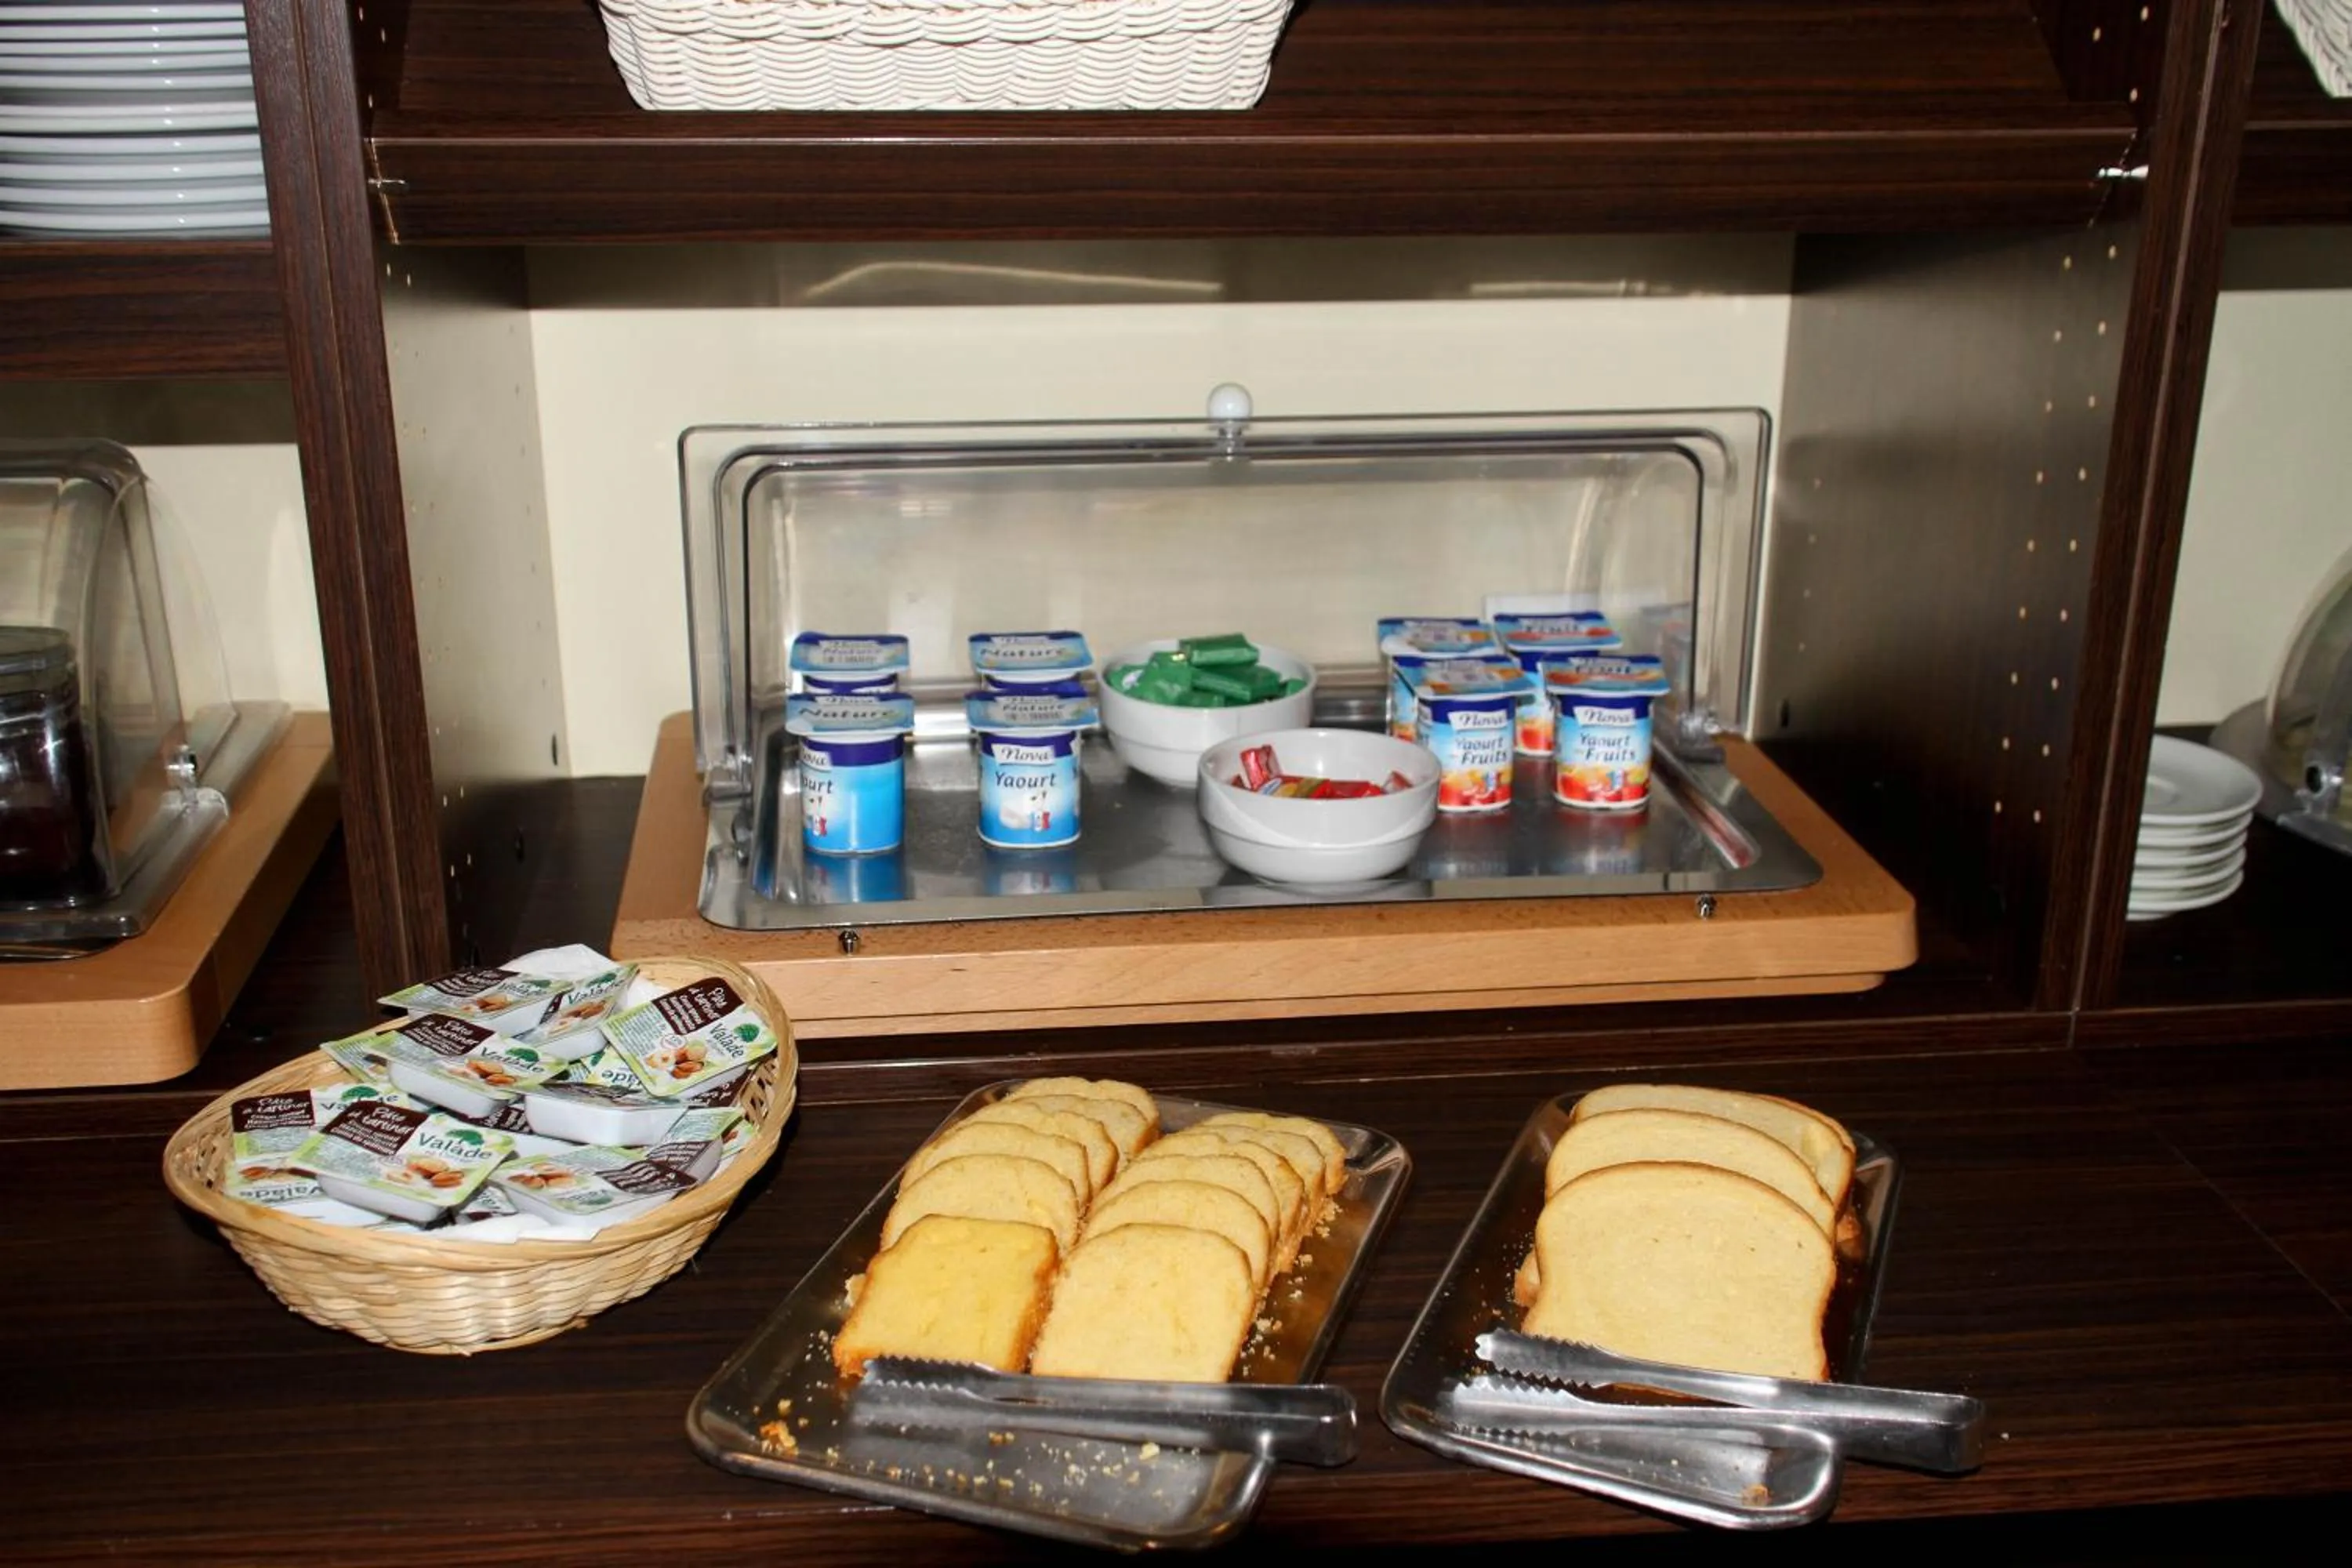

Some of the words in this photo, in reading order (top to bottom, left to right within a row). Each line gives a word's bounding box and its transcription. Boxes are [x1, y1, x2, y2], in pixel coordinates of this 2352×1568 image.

[798, 707, 897, 719] Nature
[1459, 713, 1504, 726] Nova
[1584, 709, 1631, 723] Nova
[1580, 733, 1631, 748] Yaourt
[1000, 746, 1050, 761] Nova
[1461, 750, 1508, 764] Fruits
[1585, 748, 1636, 762] Fruits
[994, 771, 1057, 789] Yaourt
[709, 1023, 745, 1058] Valade
[418, 1131, 493, 1160] Valade
